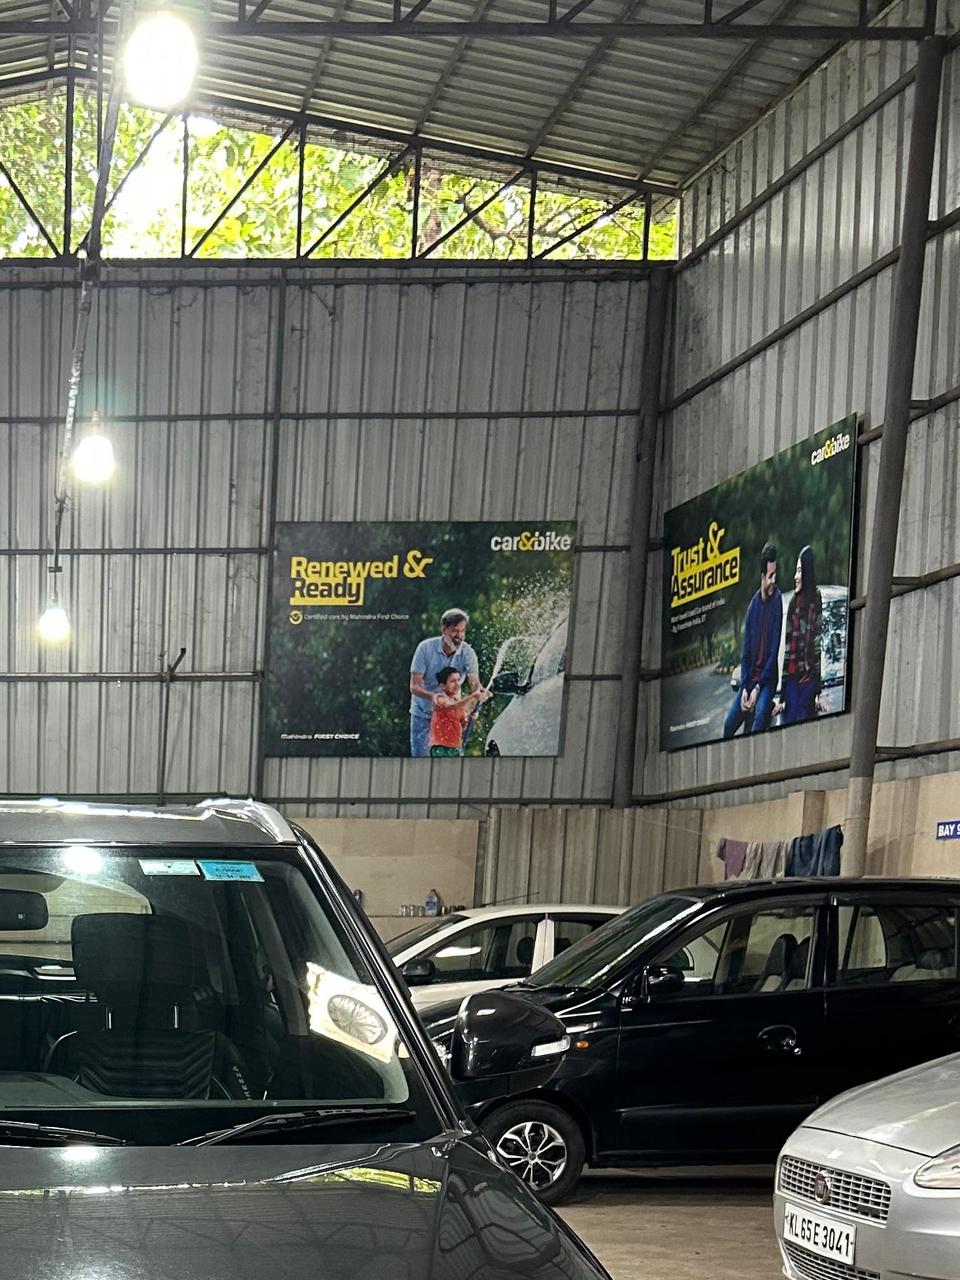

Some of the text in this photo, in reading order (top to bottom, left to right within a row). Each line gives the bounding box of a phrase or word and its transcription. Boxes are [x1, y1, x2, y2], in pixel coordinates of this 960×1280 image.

[811, 433, 850, 465] car&bike
[490, 531, 572, 552] car&bike
[671, 521, 725, 576] Trust &
[290, 550, 434, 579] Renewed &
[671, 556, 738, 601] Assurance
[292, 577, 362, 603] Ready
[938, 824, 955, 837] BAY
[789, 1211, 850, 1257] KL 65 E 3041
